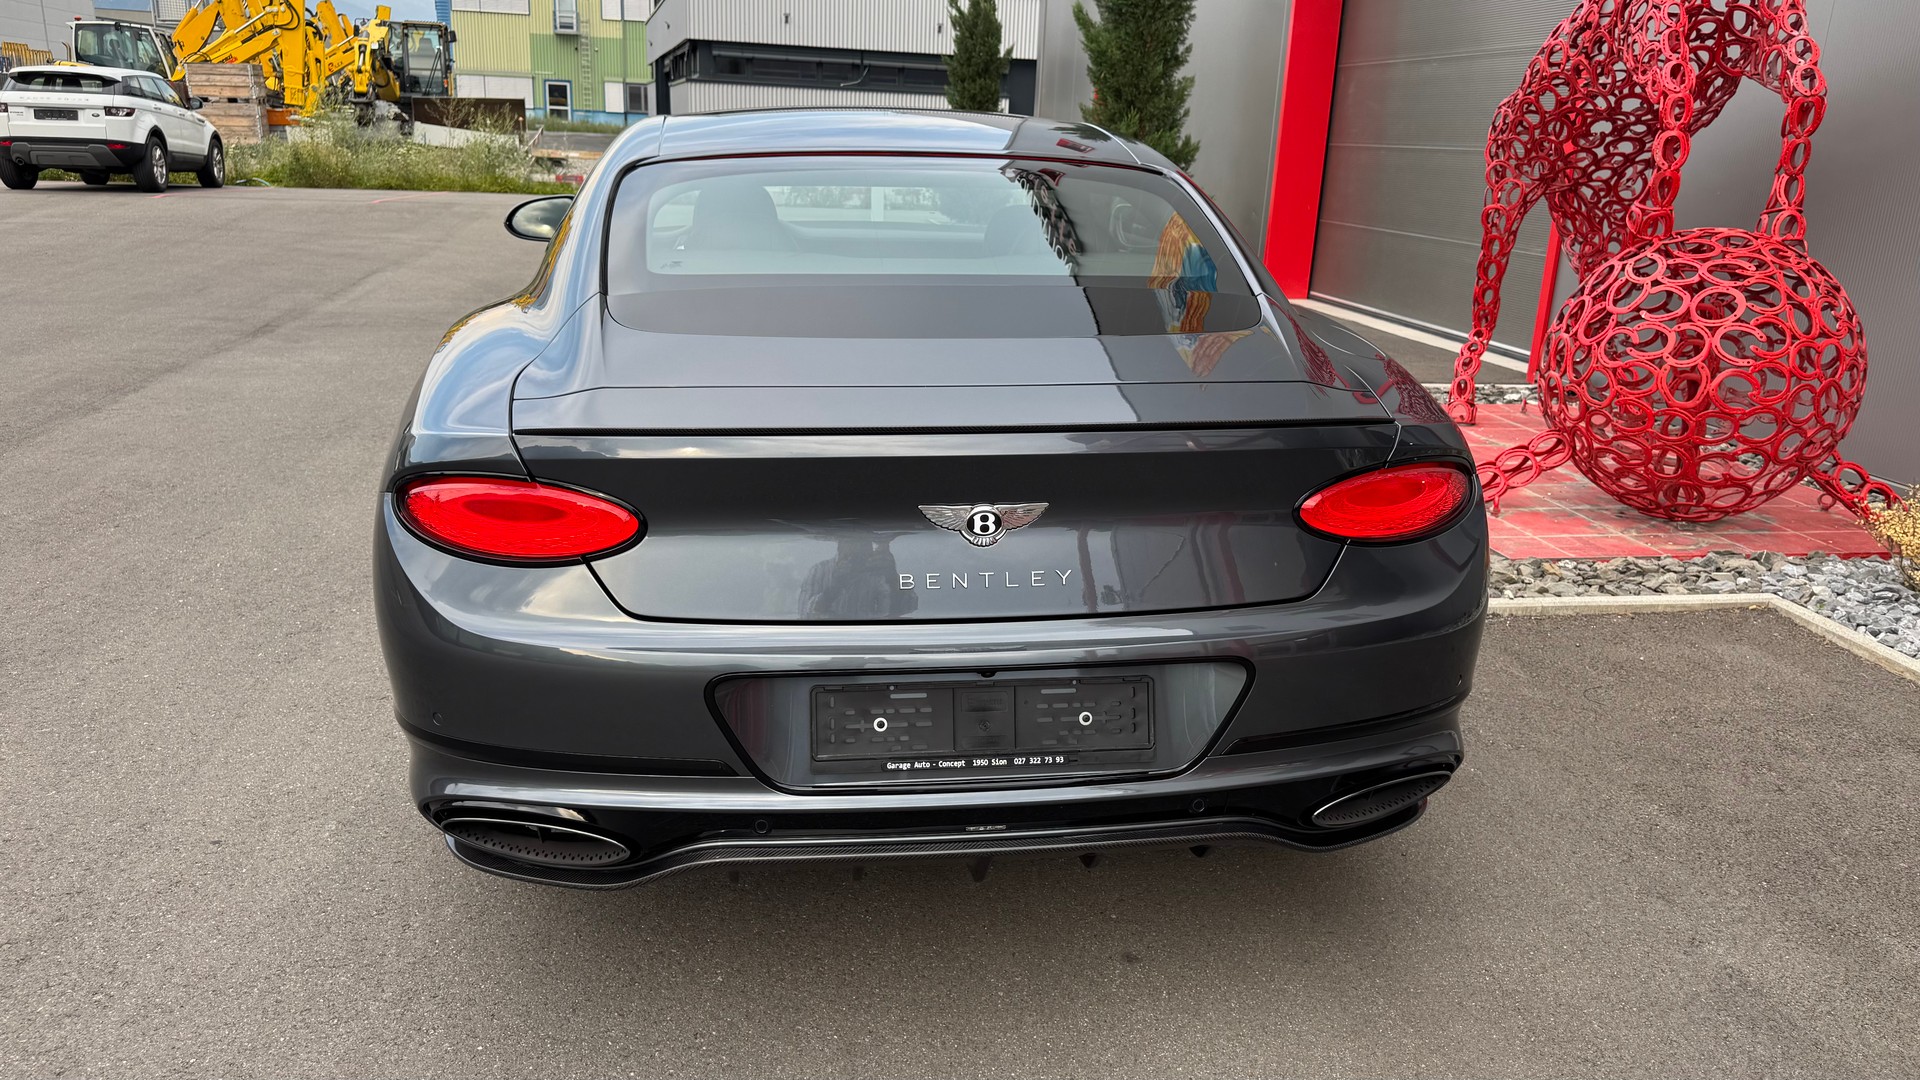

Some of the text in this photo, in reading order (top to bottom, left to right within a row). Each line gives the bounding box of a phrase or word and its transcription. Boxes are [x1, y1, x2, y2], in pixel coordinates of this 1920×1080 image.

[899, 569, 1073, 590] BENTLEY
[886, 762, 911, 771] Garage
[914, 761, 931, 769] Auto
[938, 760, 966, 769] Concept
[972, 759, 989, 767] 1950
[991, 758, 1008, 766] Sion
[1013, 757, 1026, 765] 027
[1044, 756, 1053, 764] 73
[1055, 755, 1064, 763] 93
